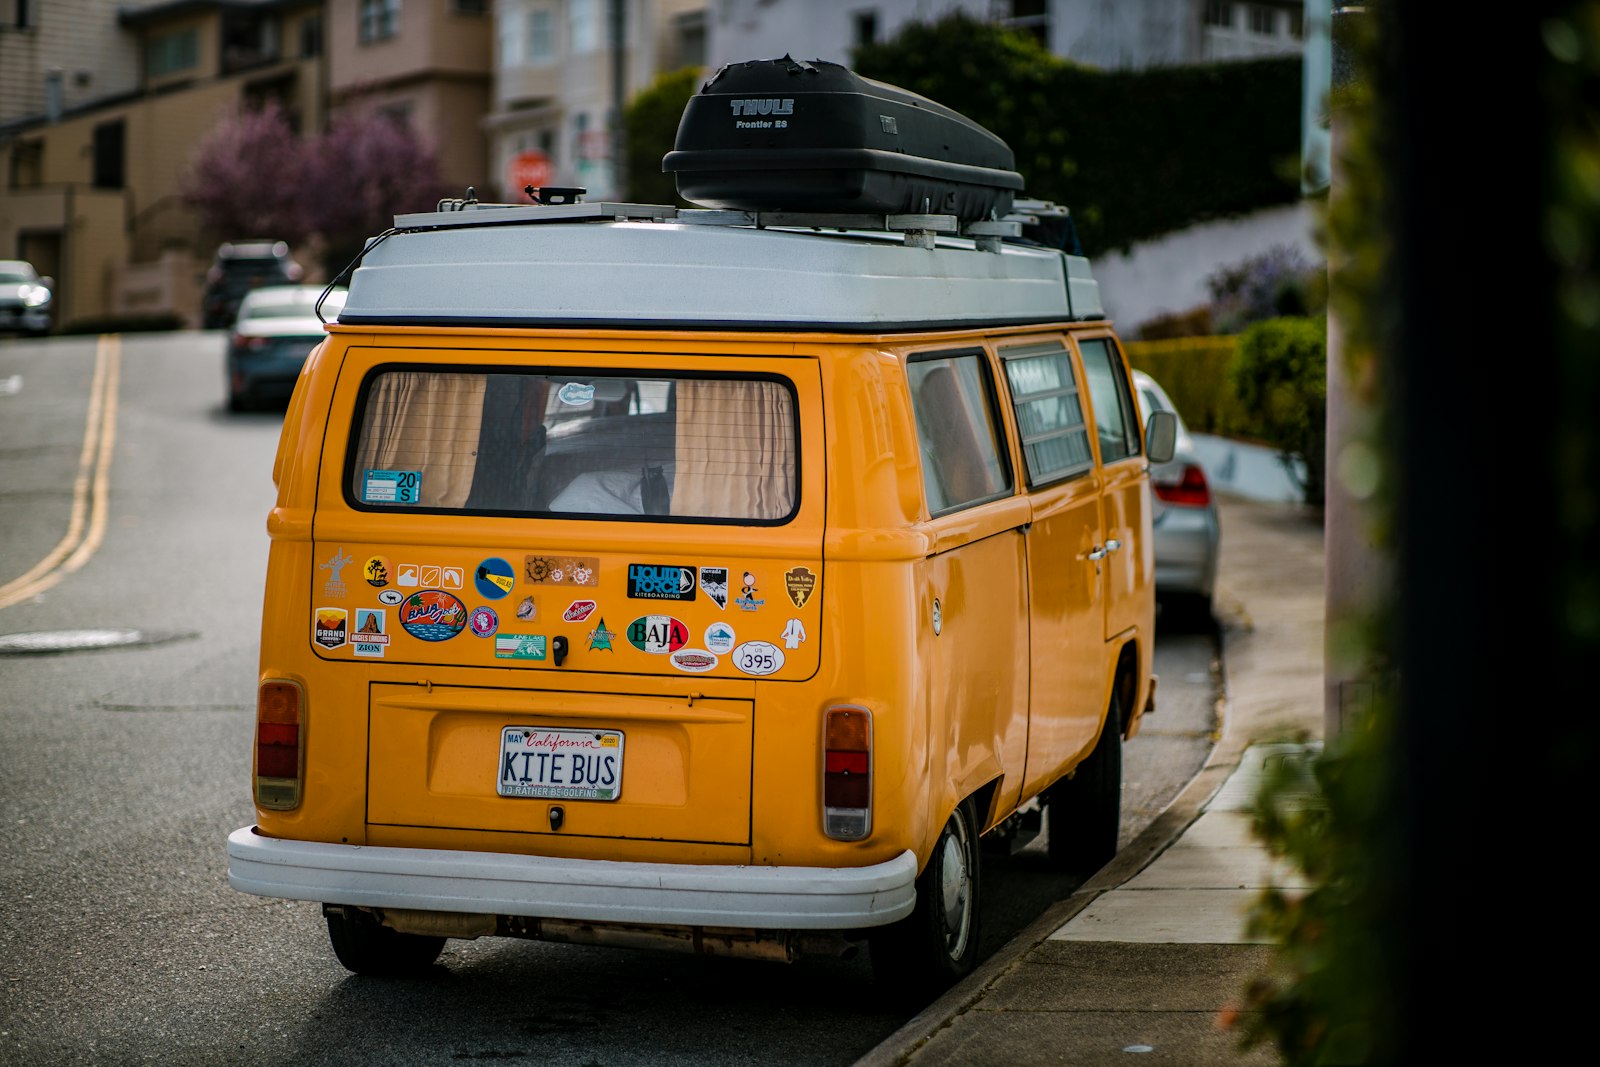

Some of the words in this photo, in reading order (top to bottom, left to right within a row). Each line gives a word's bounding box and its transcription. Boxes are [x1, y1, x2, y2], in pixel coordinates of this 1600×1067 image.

[730, 99, 795, 116] THULE
[736, 120, 773, 129] Frontier
[775, 120, 788, 129] ES
[397, 472, 416, 489] 20
[400, 488, 411, 502] S
[630, 565, 682, 582] LIQUID
[635, 579, 681, 594] FORCE
[407, 602, 440, 622] BAJA
[317, 629, 345, 638] GRAND
[632, 623, 684, 648] BAJA
[357, 644, 381, 652] ZION
[744, 654, 773, 669] 395
[507, 734, 524, 744] MAY
[526, 732, 601, 752] California
[503, 751, 565, 783] KITE
[570, 754, 615, 785] BUS
[515, 787, 548, 796] RATHER
[550, 788, 561, 797] BE
[562, 789, 598, 798] GOLFING
